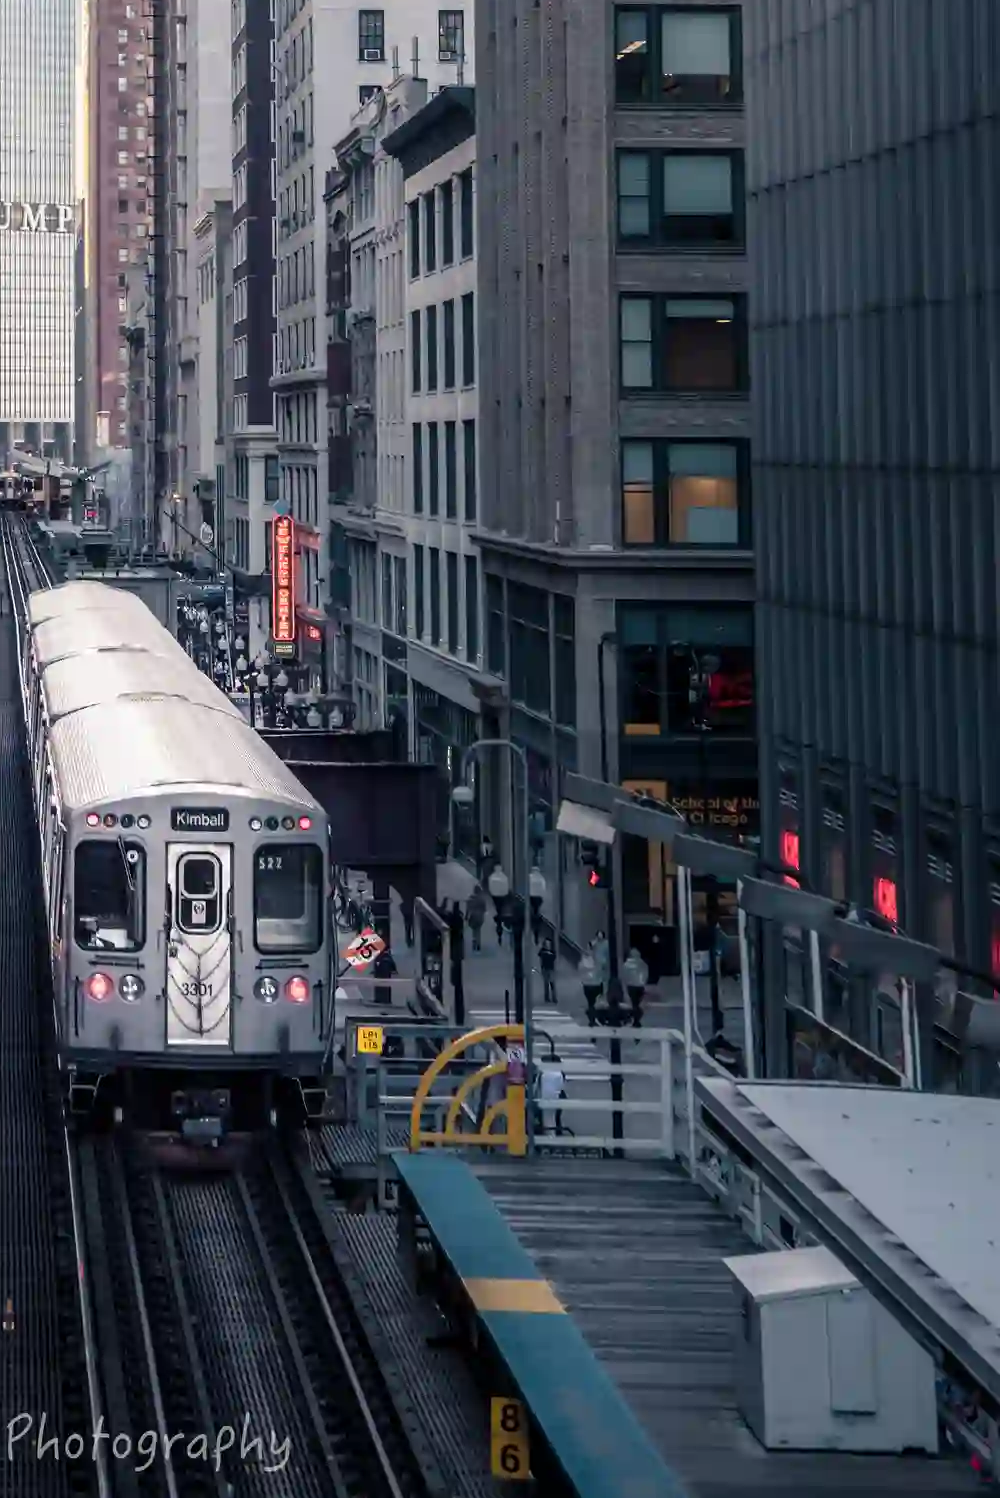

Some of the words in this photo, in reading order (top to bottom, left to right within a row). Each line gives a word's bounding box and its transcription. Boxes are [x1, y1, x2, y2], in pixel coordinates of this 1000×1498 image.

[277, 588, 290, 639] CENTER
[176, 811, 224, 827] Kimball
[355, 937, 378, 959] 15
[181, 982, 213, 996] 3301
[501, 1404, 520, 1433] 8
[501, 1444, 521, 1474] 6
